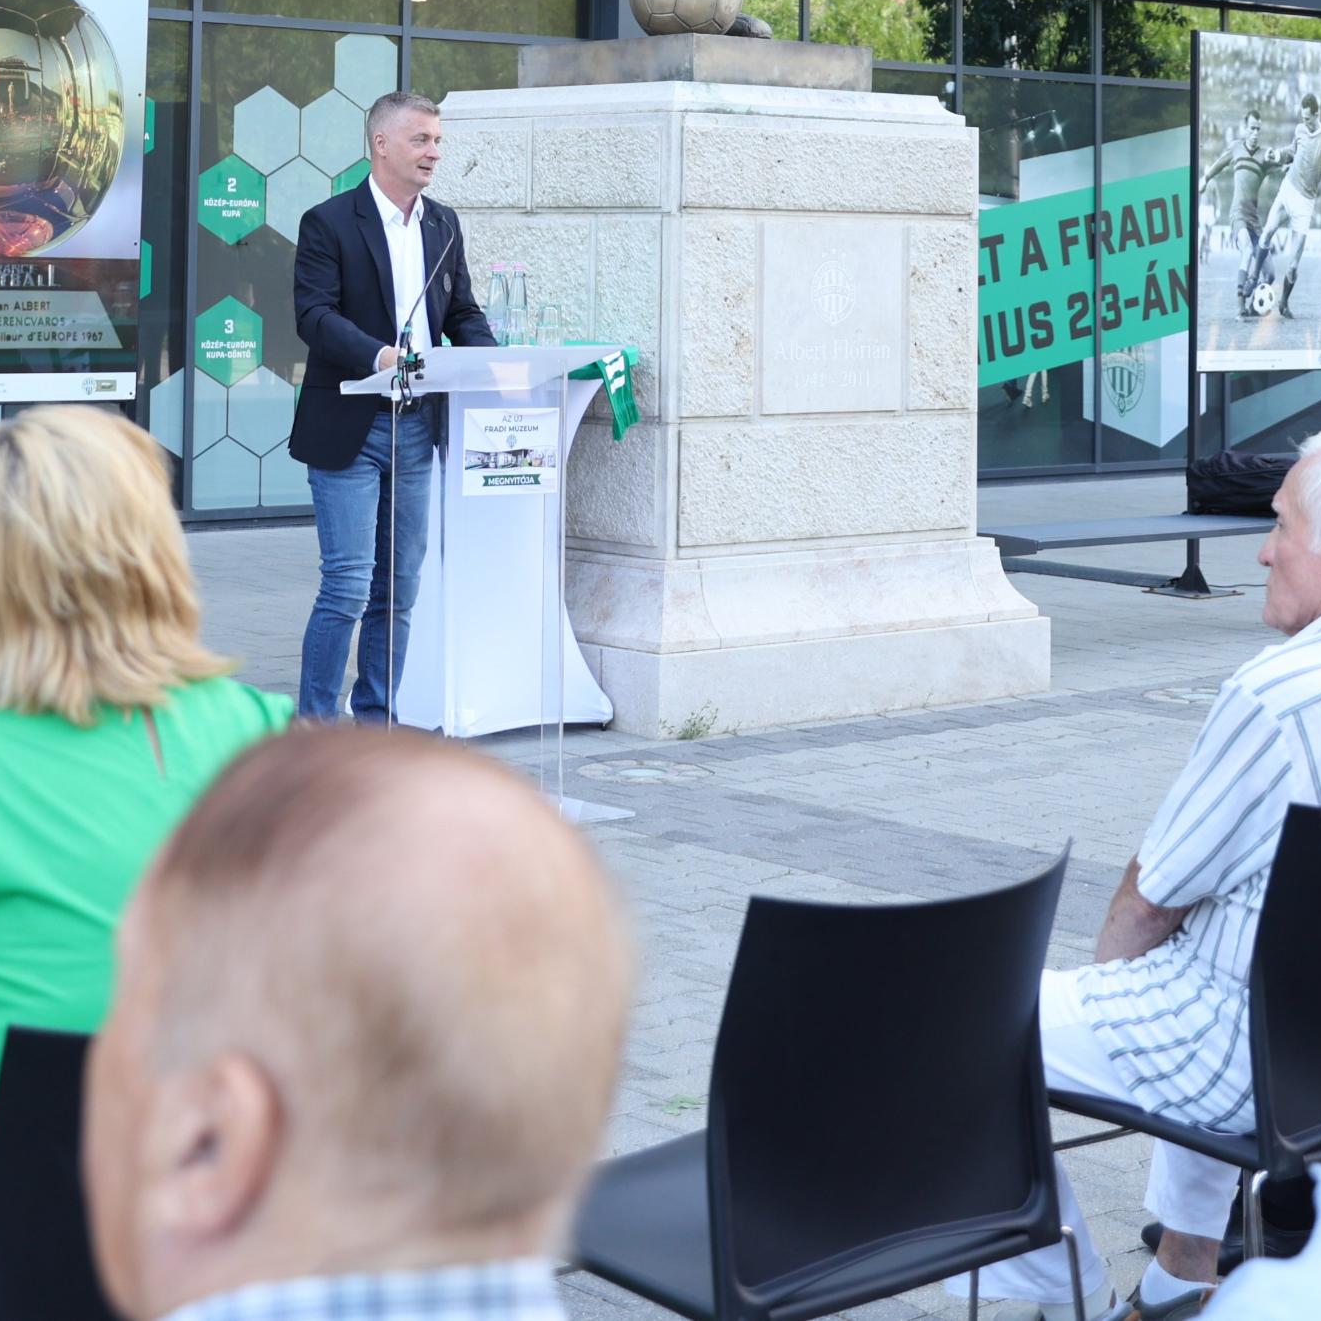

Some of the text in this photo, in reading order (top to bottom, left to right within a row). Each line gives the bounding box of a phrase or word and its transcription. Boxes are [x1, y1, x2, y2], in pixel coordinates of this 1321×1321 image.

[227, 177, 237, 192] 2
[222, 210, 241, 218] KUPA
[1020, 226, 1049, 277] A
[1058, 194, 1183, 267] FRADI
[14, 301, 51, 311] ALBERT
[1067, 259, 1190, 341] 23-ÁN
[224, 319, 234, 334] 3
[27, 331, 78, 342] d'EUROPE
[81, 331, 104, 343] 1967
[774, 340, 827, 360] Albert
[484, 425, 507, 433] FRADI
[488, 476, 535, 485] MEGNYITÓJA
